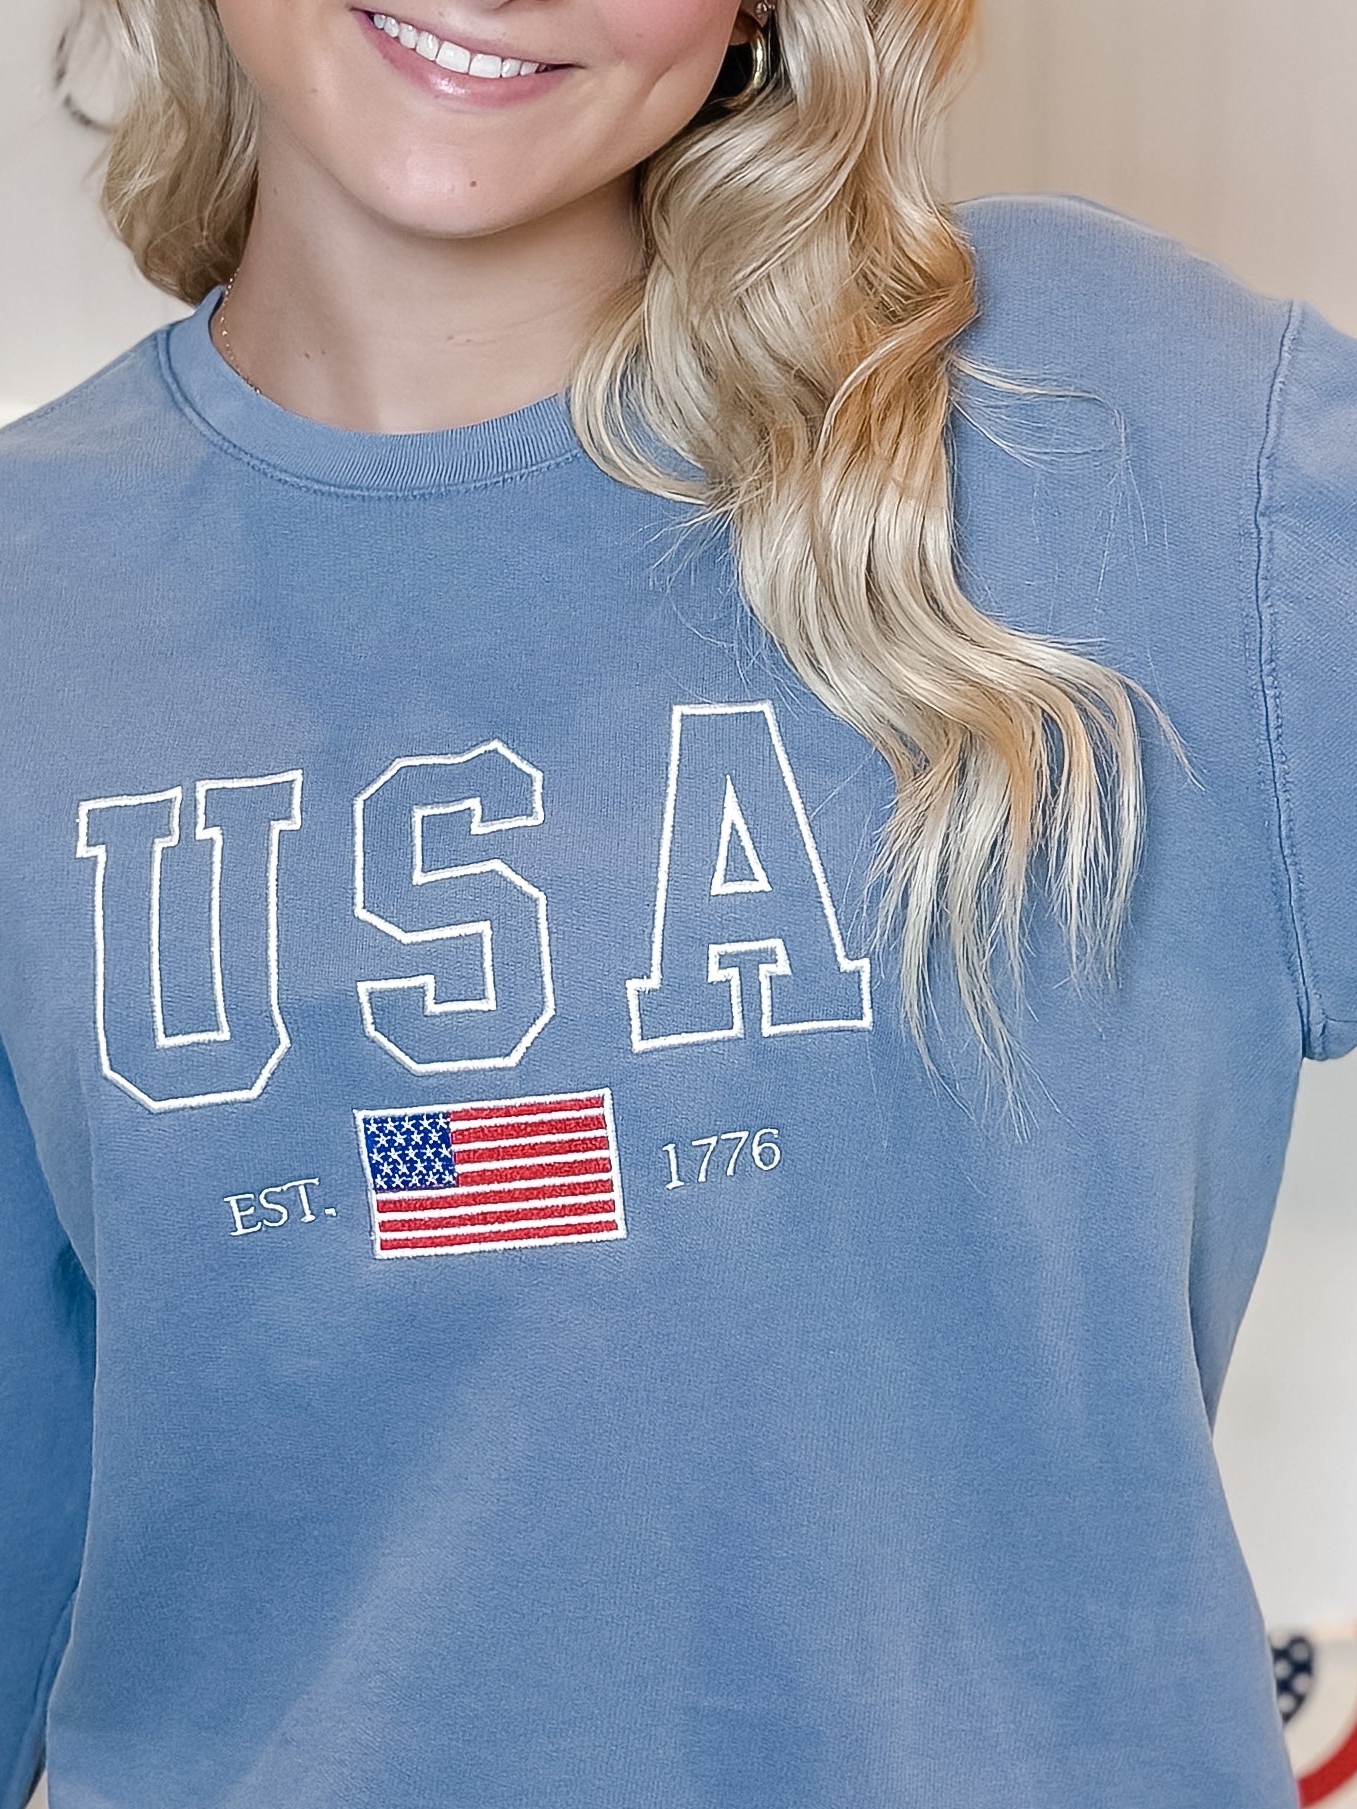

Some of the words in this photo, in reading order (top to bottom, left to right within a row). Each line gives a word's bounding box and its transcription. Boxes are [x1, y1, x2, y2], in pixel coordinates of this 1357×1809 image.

[75, 700, 873, 1114] USA
[224, 1177, 338, 1237] EST.
[662, 1128, 782, 1190] 1776
